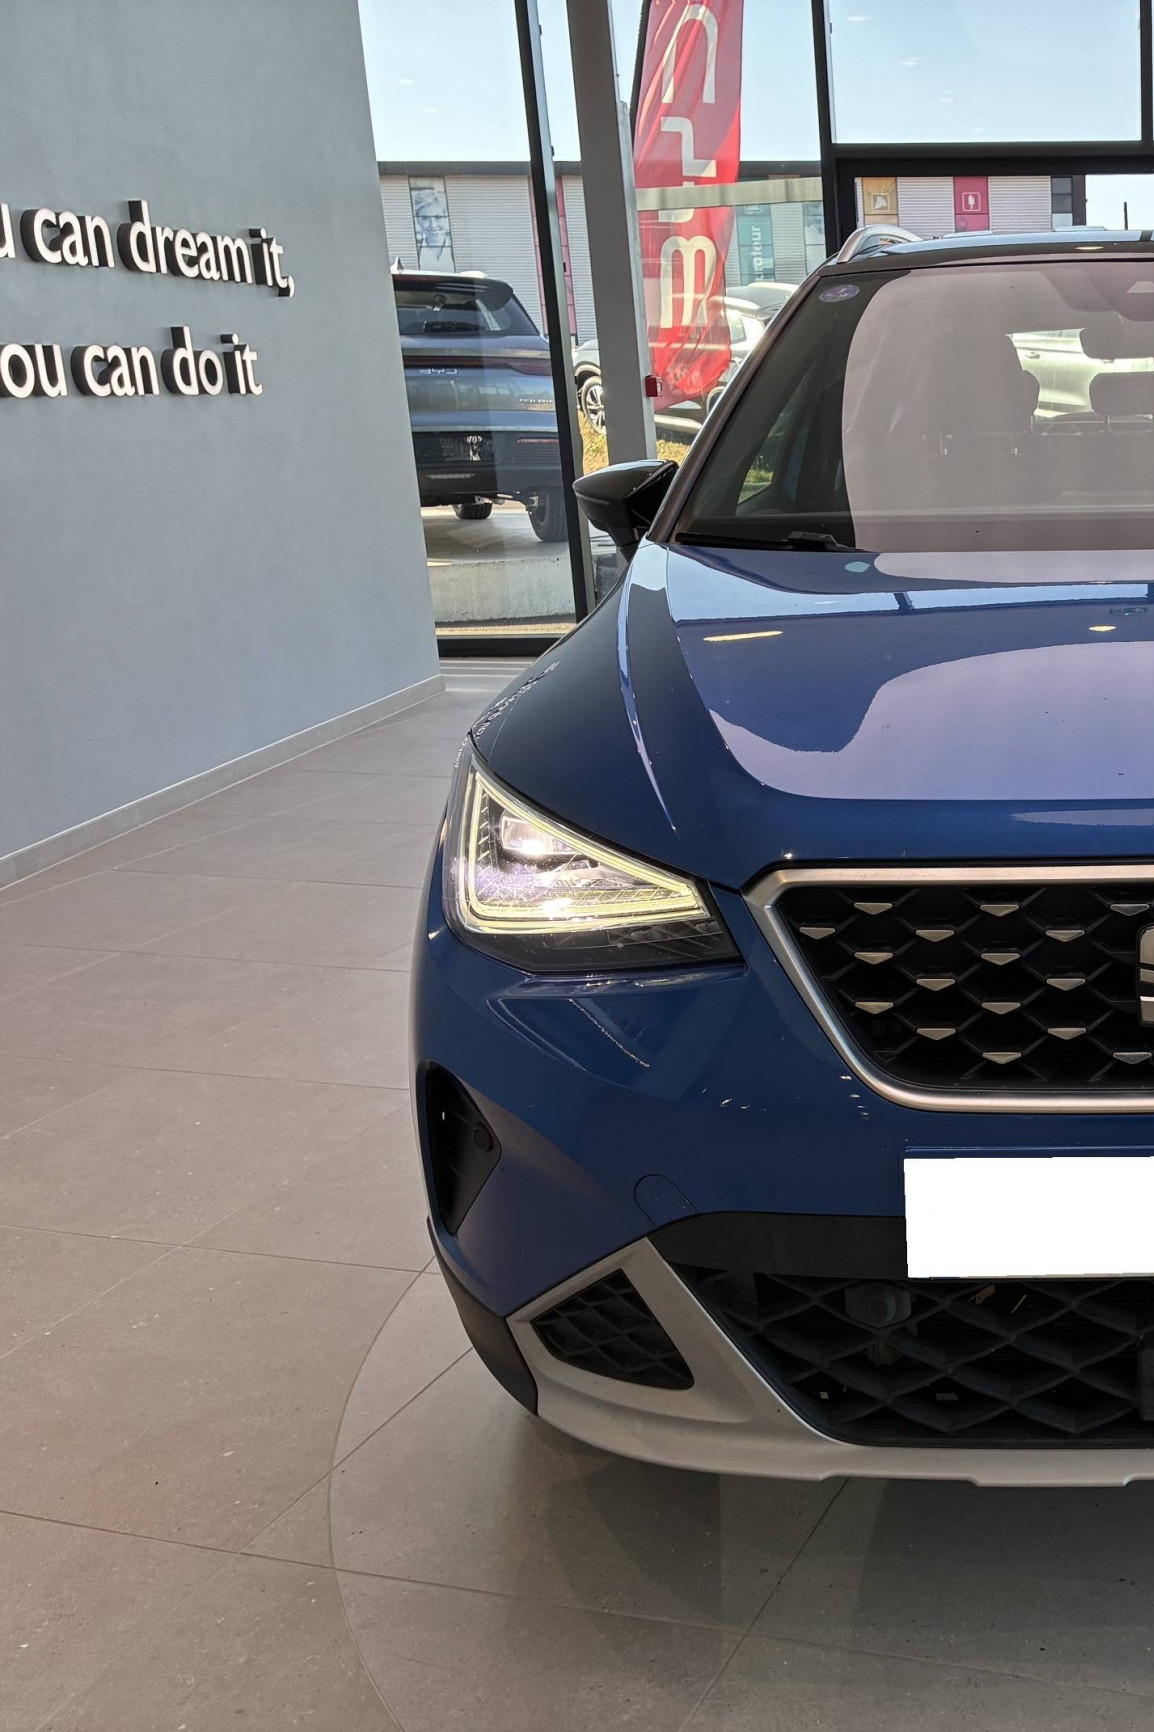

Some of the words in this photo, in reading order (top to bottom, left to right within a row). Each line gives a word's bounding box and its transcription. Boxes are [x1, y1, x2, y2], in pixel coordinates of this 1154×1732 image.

[20, 207, 116, 268] can
[117, 199, 253, 284] dream
[249, 227, 296, 297] it,
[70, 344, 160, 397] can
[161, 325, 224, 396] do
[220, 332, 263, 396] it
